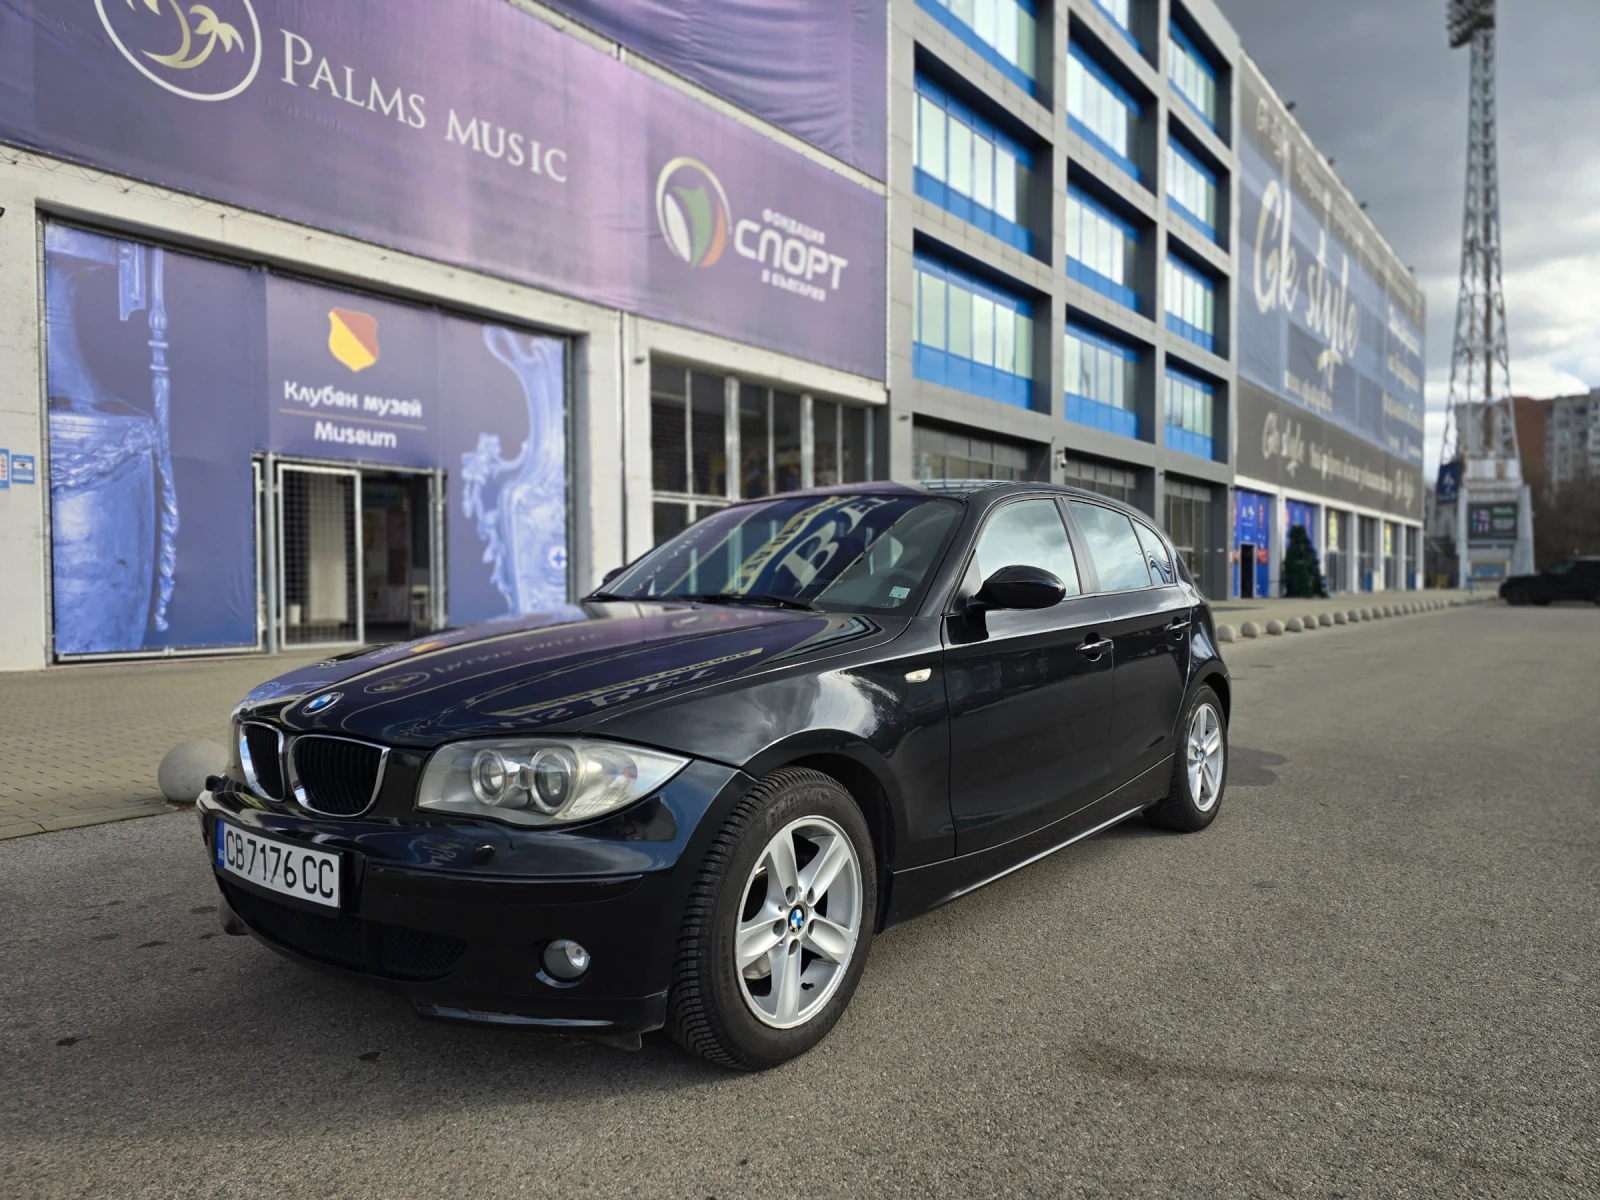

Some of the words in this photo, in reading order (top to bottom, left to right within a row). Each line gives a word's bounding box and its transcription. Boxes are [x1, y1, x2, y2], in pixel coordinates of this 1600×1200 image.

[279, 28, 426, 129] PALMS
[444, 108, 568, 183] MUSIC
[734, 219, 848, 289] СПОРТ
[1306, 229, 1358, 358] style
[284, 380, 358, 409] Клубен
[363, 393, 423, 418] музей
[314, 420, 397, 449] Museum
